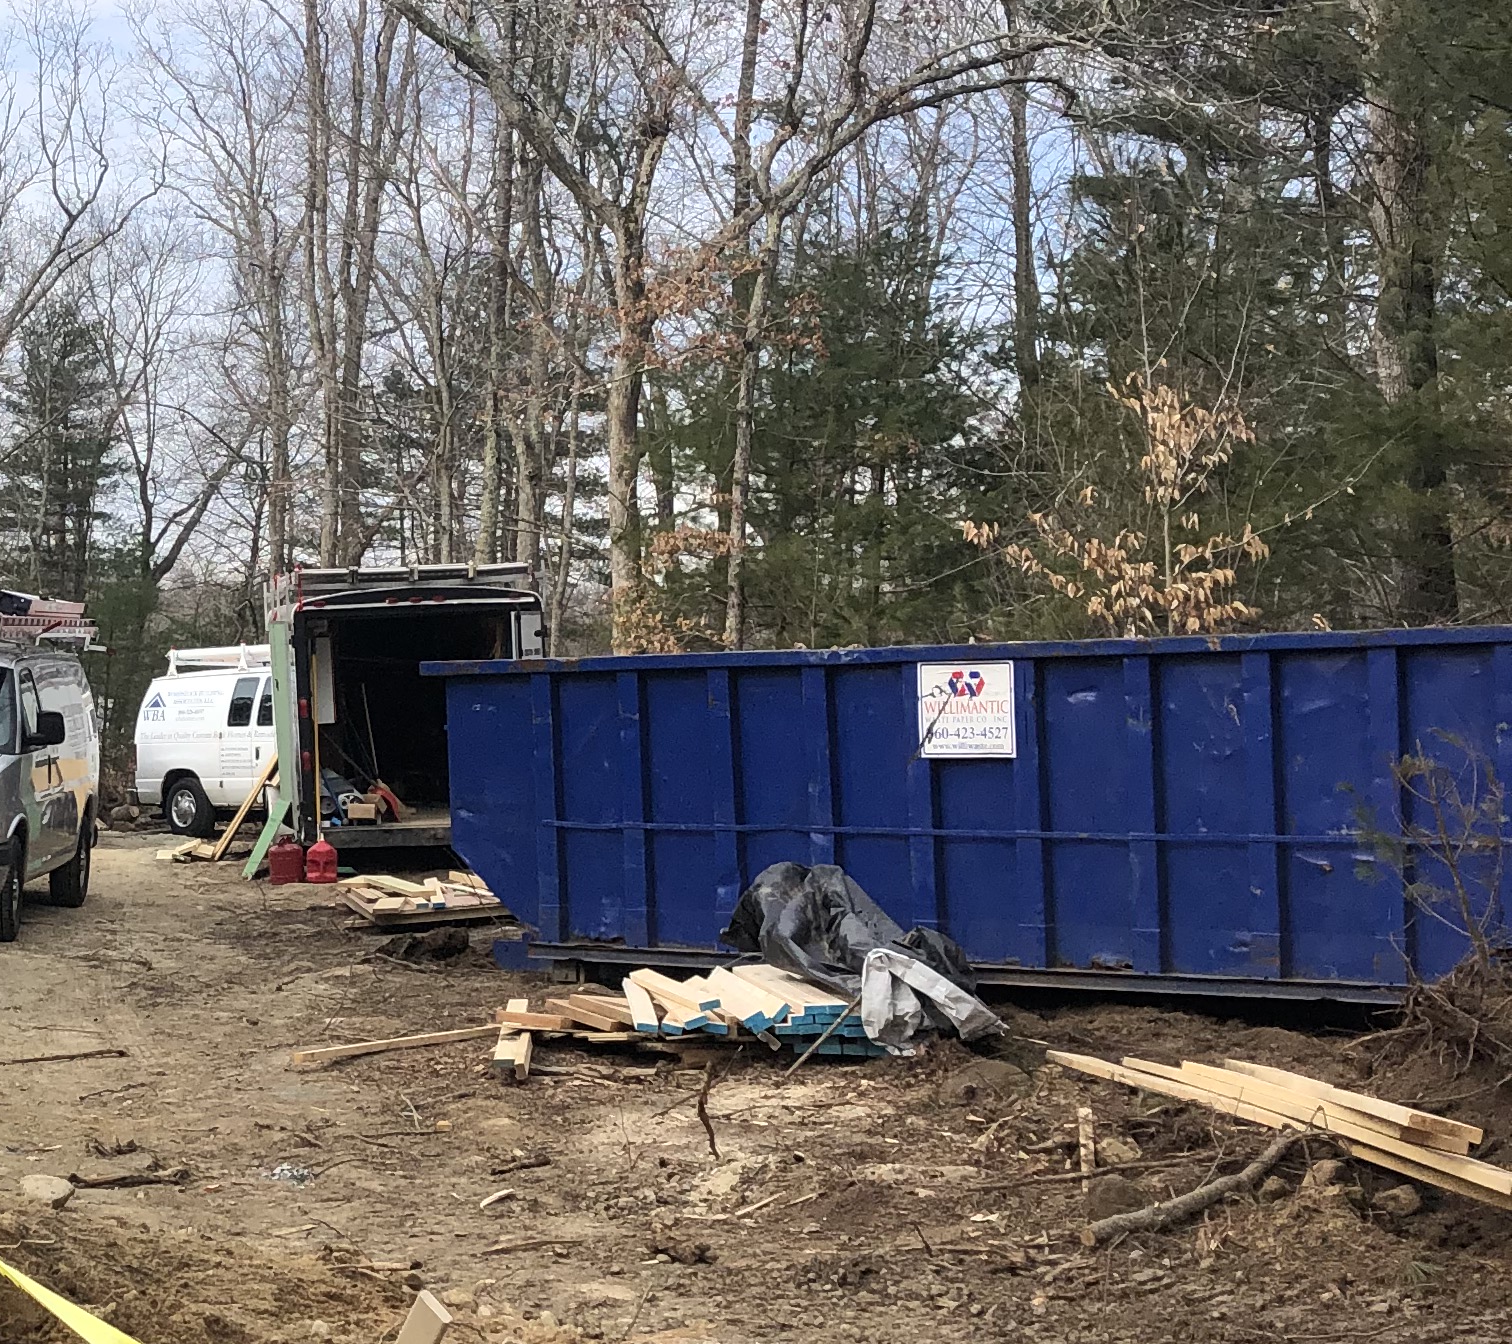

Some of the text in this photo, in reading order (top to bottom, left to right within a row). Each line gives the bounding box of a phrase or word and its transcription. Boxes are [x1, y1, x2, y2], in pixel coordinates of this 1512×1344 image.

[924, 700, 1009, 714] WILLIMANTIC
[143, 709, 166, 721] WBA
[927, 726, 1009, 740] 60-423-4527
